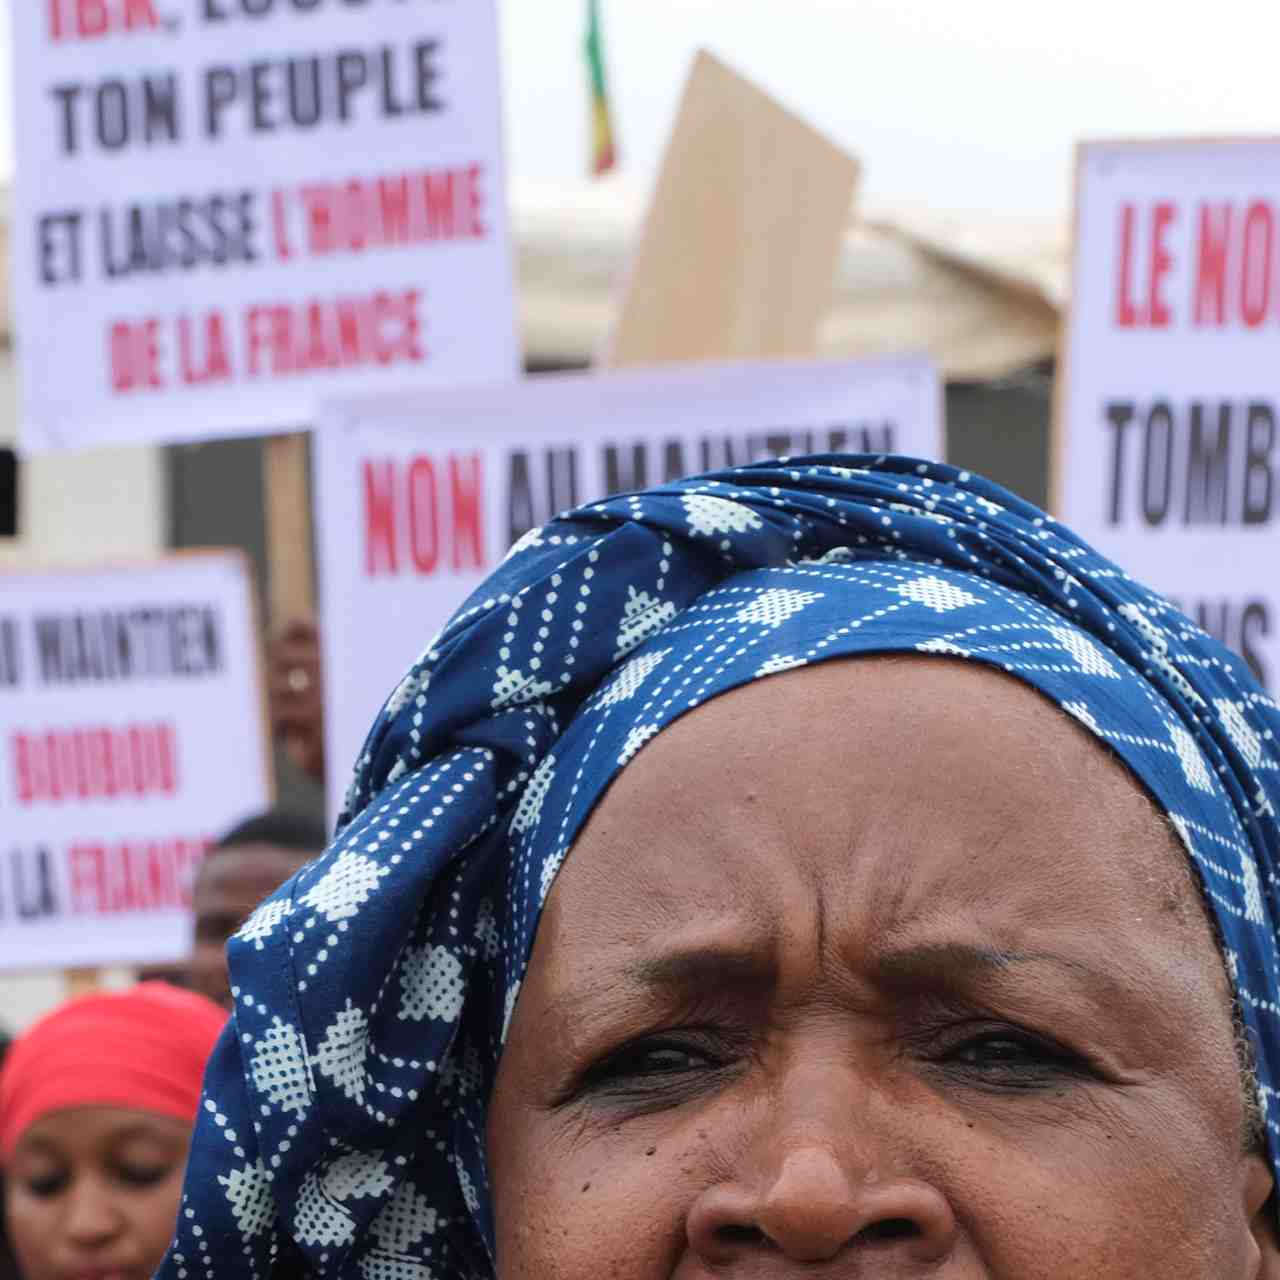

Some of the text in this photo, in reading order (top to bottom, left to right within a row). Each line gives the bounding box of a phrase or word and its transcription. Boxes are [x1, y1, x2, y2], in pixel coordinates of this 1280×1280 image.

[49, 40, 445, 156] TON PEUPLE
[37, 162, 487, 285] ET LAISSE L'HOMME
[1113, 200, 1177, 330] LE
[106, 288, 425, 395] DE LA FRANCE
[362, 452, 486, 578] NON
[34, 605, 222, 682] MAINTIEN
[12, 721, 178, 806] BOUBOU
[12, 847, 57, 918] LA
[68, 838, 216, 913] FRANC
